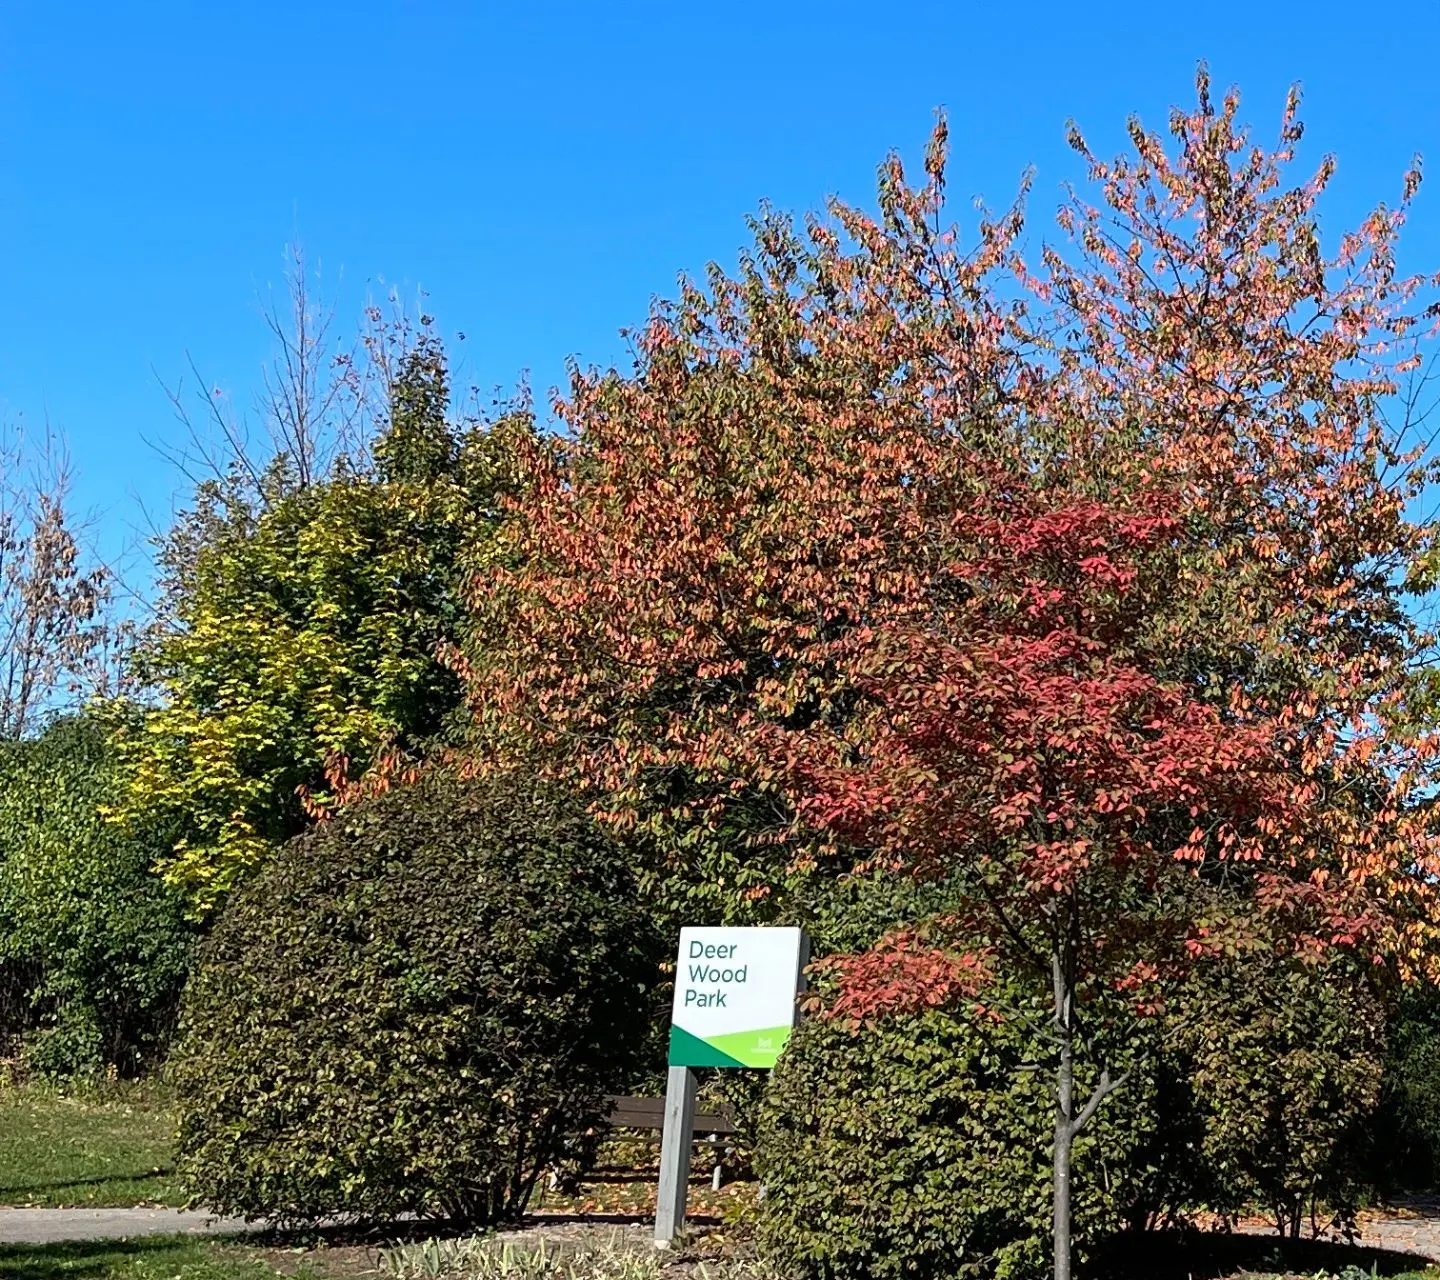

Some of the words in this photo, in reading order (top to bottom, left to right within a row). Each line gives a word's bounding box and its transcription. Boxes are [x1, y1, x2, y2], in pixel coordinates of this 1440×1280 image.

[689, 940, 737, 959] Deer
[689, 965, 747, 983] Wood
[685, 989, 727, 1008] Park
